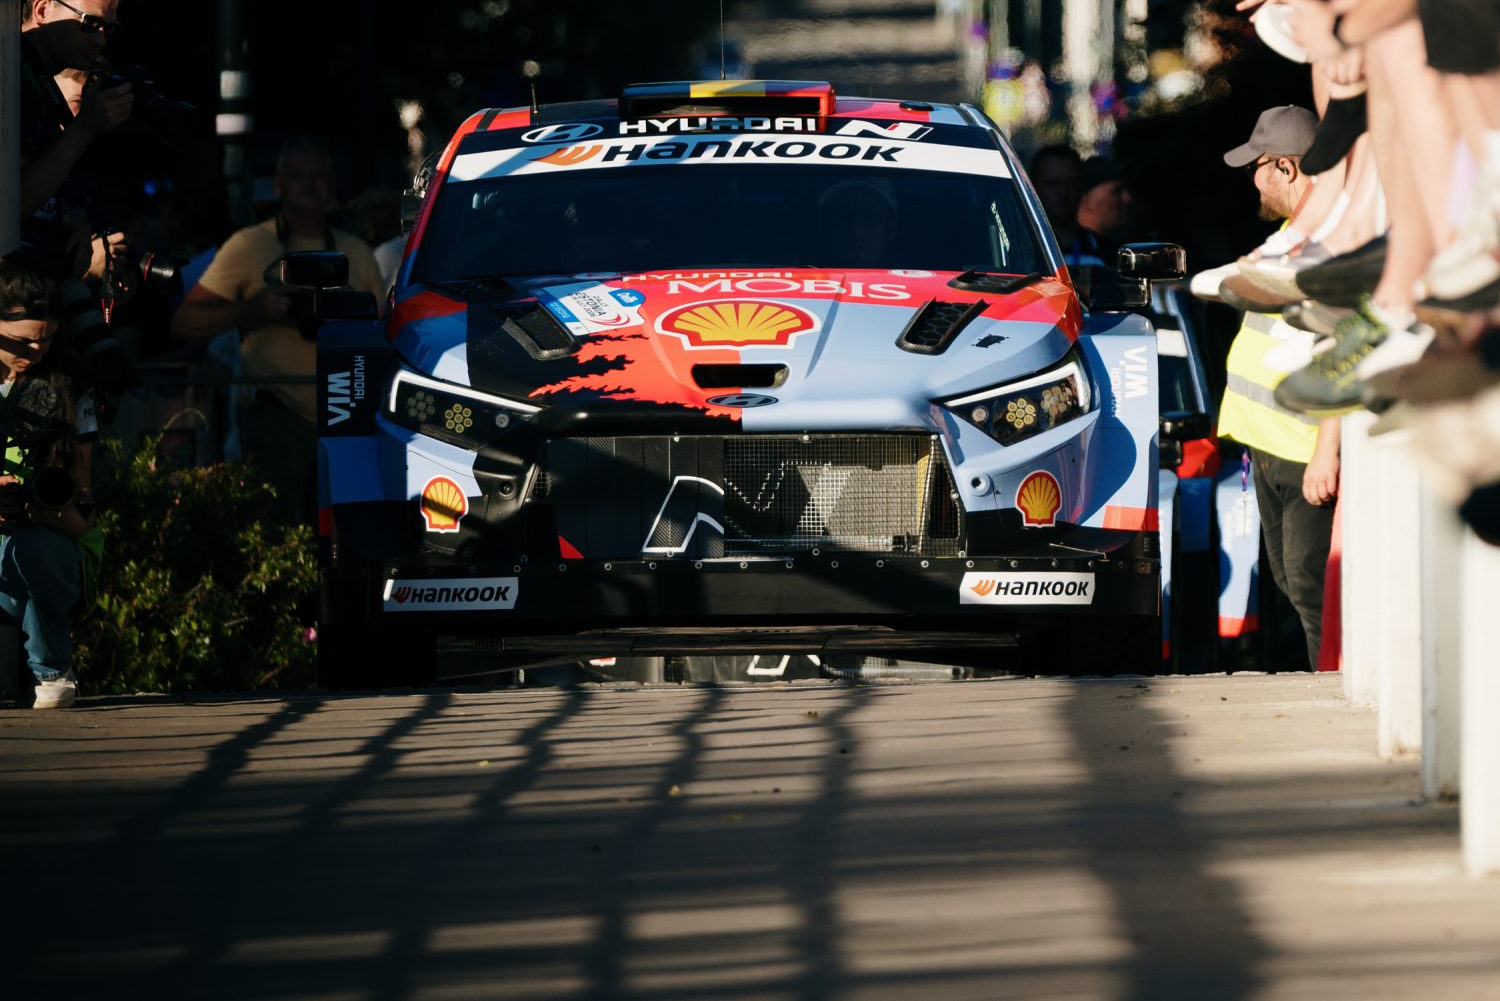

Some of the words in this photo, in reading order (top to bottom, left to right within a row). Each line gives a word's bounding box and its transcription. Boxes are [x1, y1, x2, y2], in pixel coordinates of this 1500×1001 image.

[619, 117, 816, 134] HYUNDAI
[622, 272, 794, 282] HYUNDAI
[665, 278, 912, 300] MOBIS
[575, 291, 607, 317] ESTONIA
[354, 355, 365, 400] HYUNDAI
